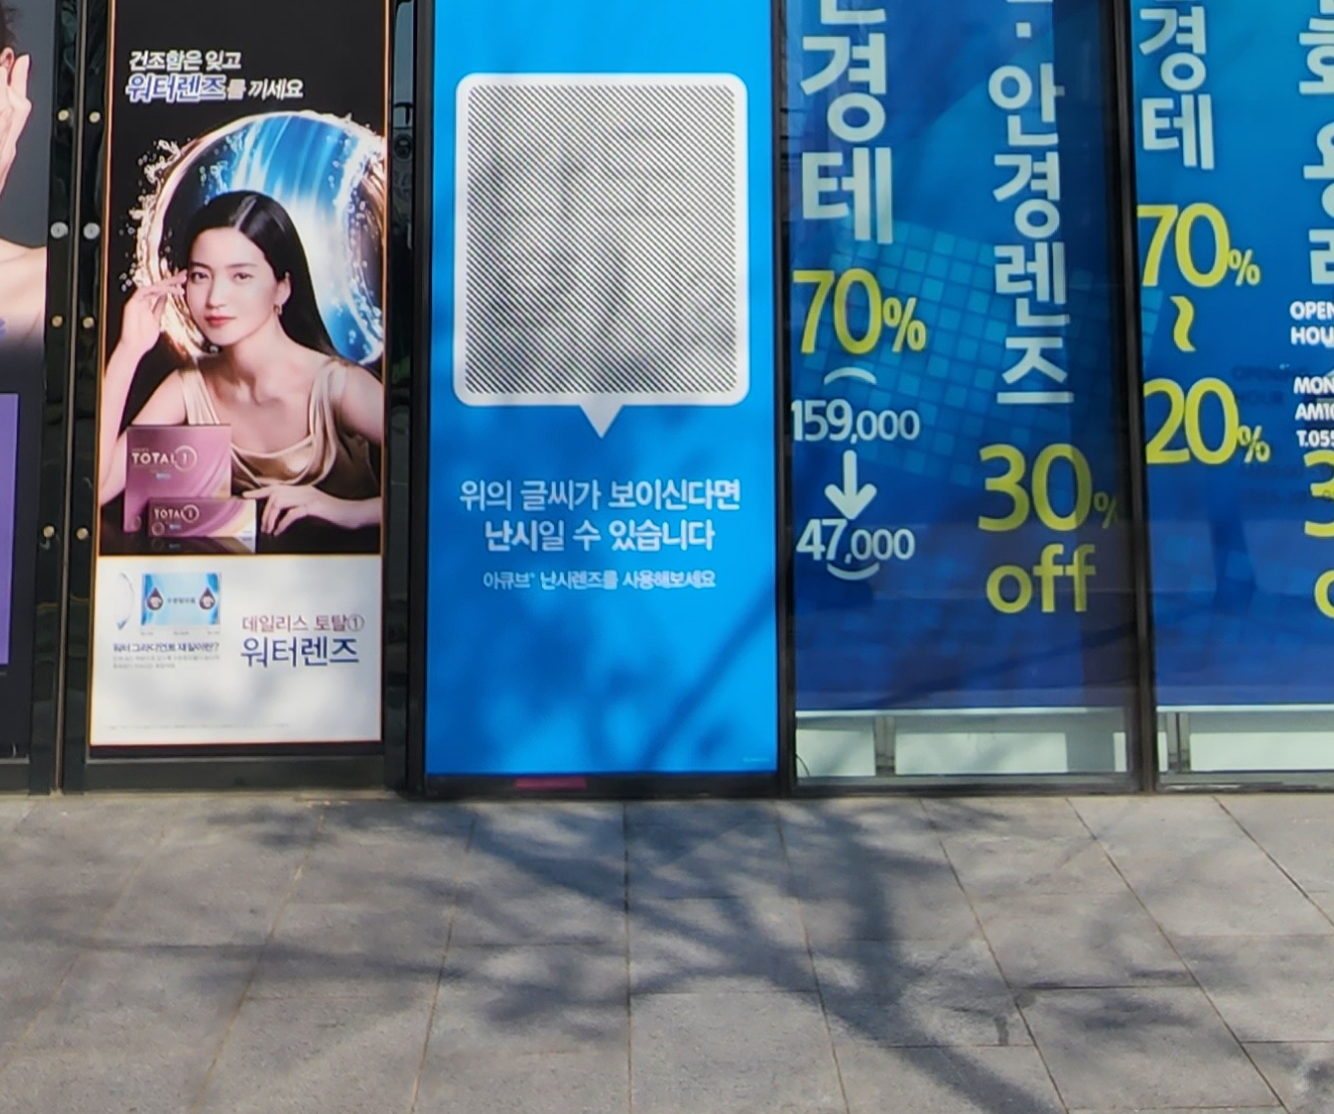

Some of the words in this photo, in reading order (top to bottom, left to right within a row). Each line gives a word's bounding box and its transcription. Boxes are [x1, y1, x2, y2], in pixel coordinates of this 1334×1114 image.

[129, 50, 203, 72] 건조함은
[125, 73, 247, 103] 워터렌즈를
[248, 79, 304, 101] 끼세요
[1137, 203, 1261, 288] 70%
[793, 268, 927, 356] 70%
[791, 398, 921, 445] 159,000
[1142, 378, 1271, 465] 20%
[459, 480, 513, 512] 위의
[520, 479, 603, 512] 글씨가
[608, 478, 741, 511] 보이신다면
[483, 519, 565, 552] 난시일
[572, 519, 601, 552] 수
[608, 518, 716, 552] 있습니다
[796, 518, 916, 564] 47,000
[622, 569, 717, 590] 사용해보세요
[986, 543, 1096, 614] off
[242, 615, 309, 633] 데일리스
[240, 636, 360, 668] 워터렌즈
